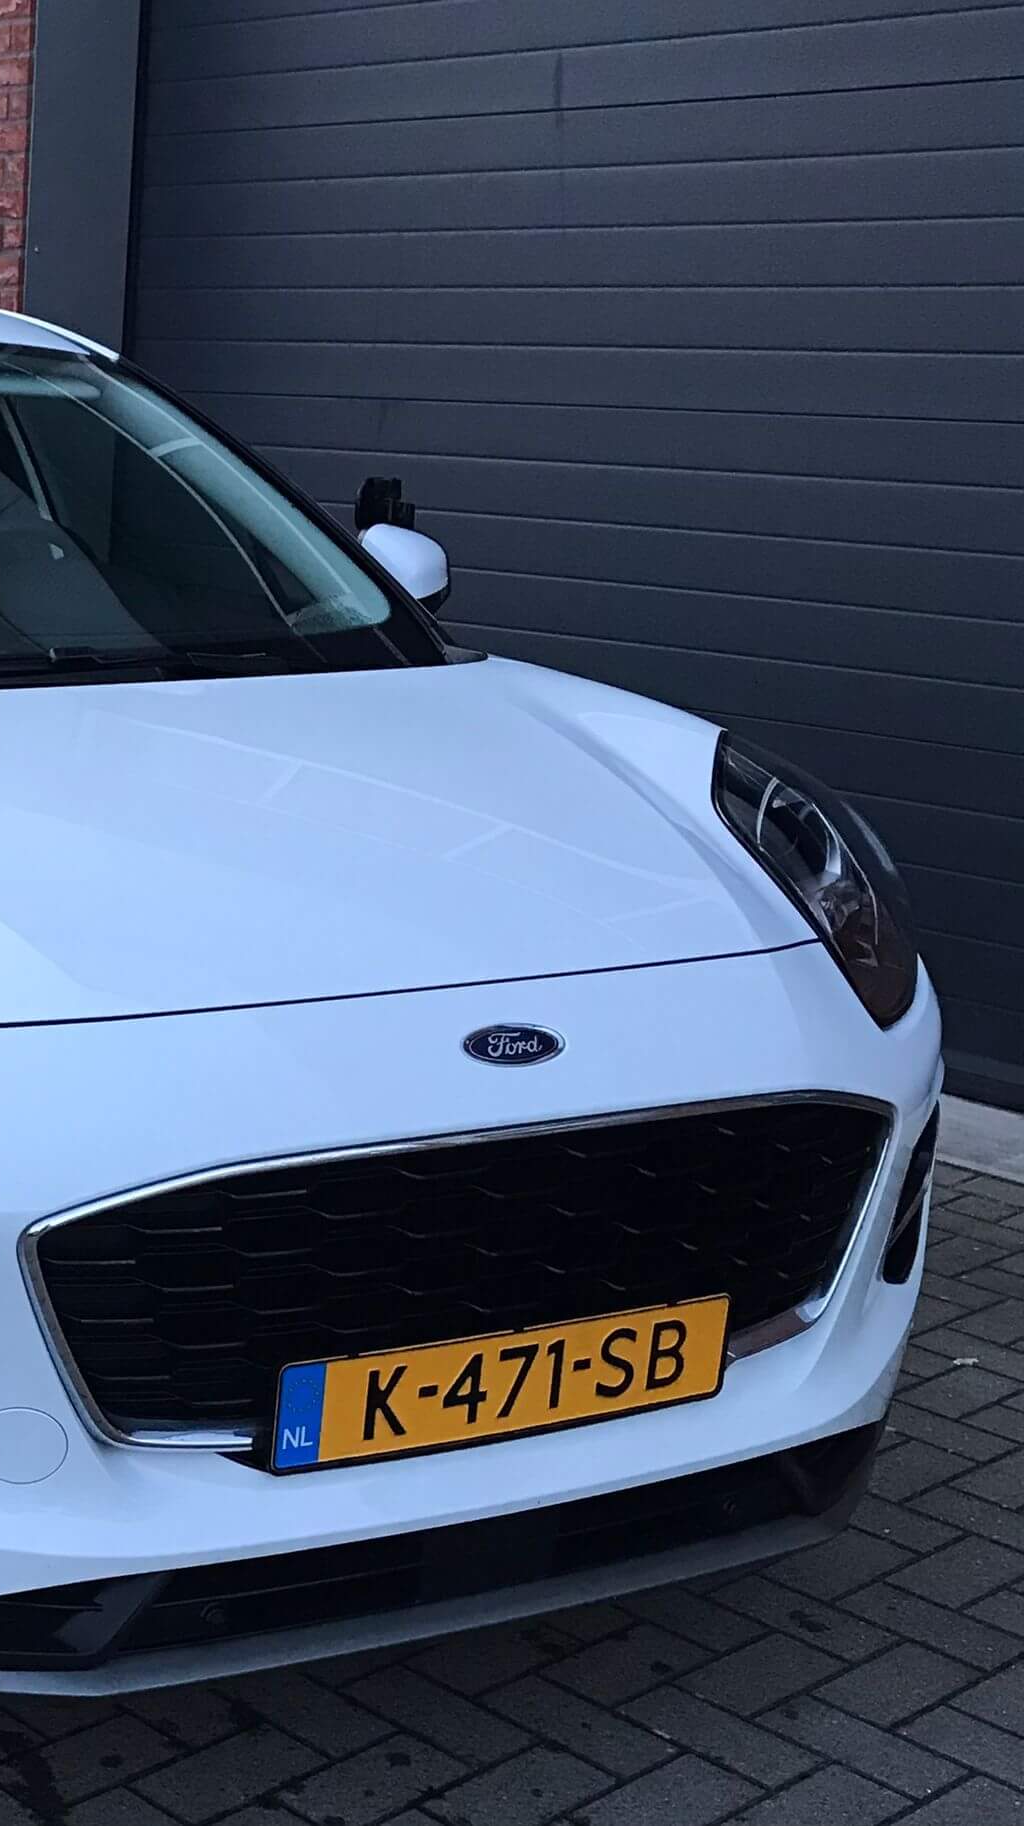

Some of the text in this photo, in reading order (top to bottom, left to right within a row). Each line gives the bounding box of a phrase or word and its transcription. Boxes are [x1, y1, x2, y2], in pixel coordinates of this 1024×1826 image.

[487, 1031, 543, 1058] Ford
[362, 1319, 688, 1441] K-471-SB
[281, 1425, 314, 1450] NL
